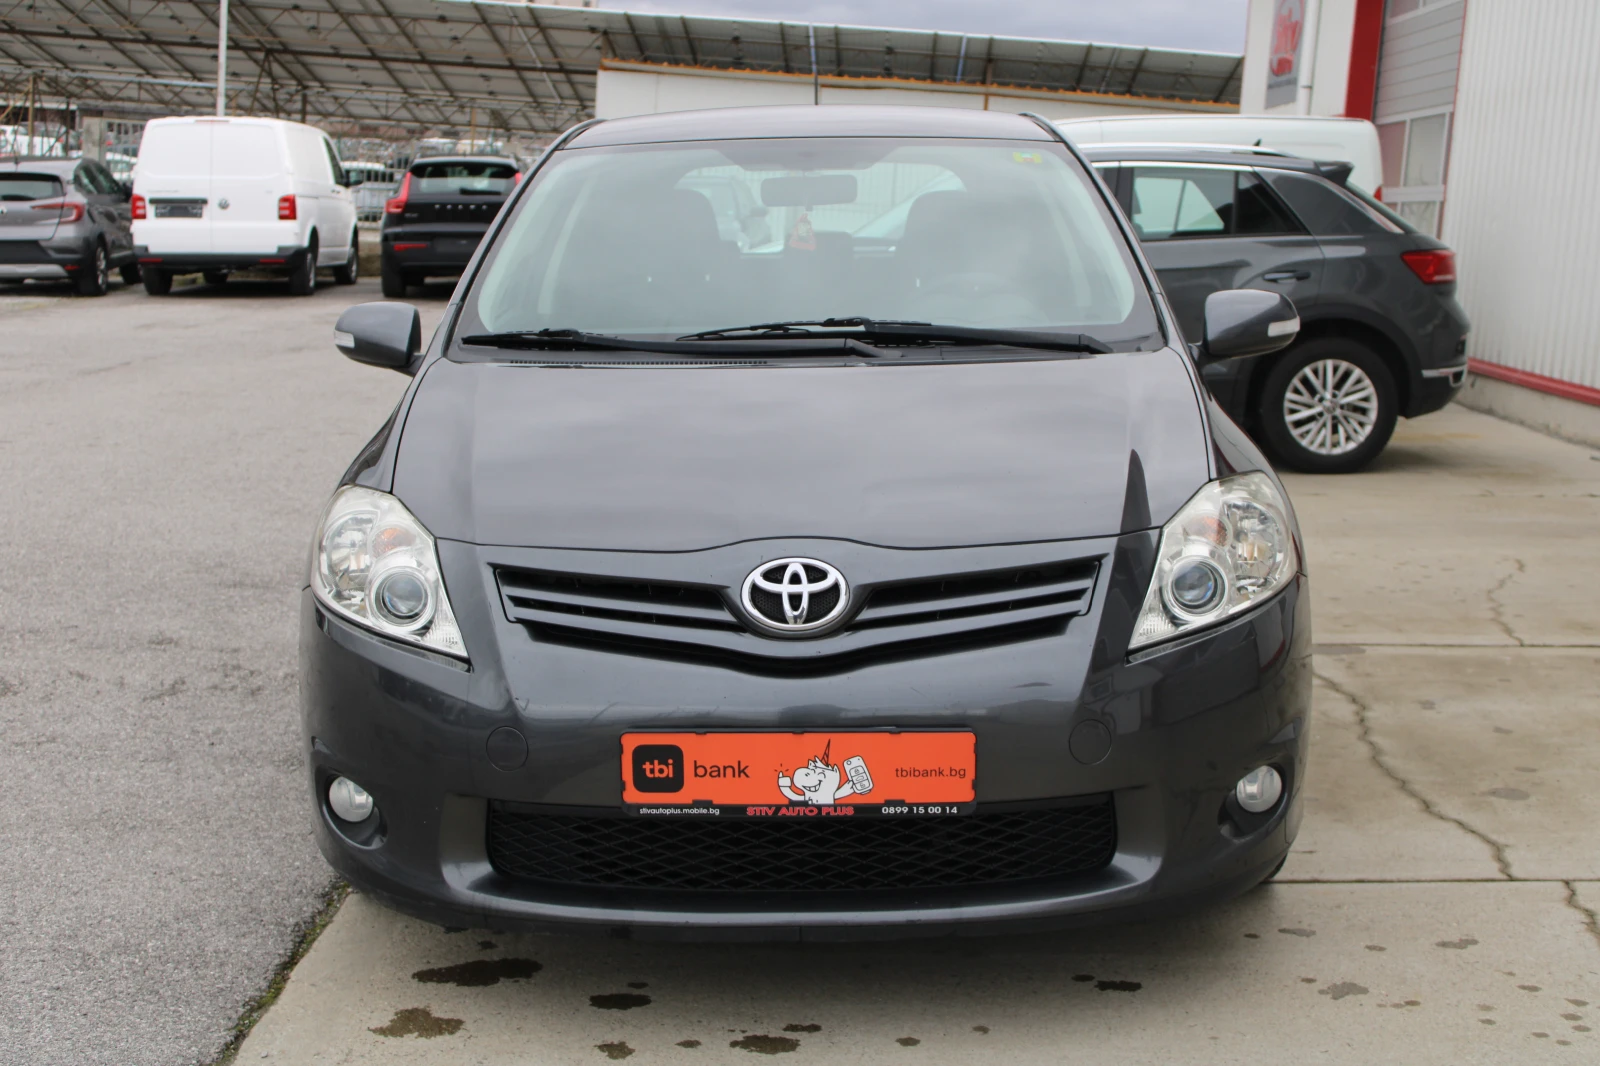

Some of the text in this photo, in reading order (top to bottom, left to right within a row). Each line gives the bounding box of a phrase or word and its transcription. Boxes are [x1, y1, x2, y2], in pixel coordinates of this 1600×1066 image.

[642, 758, 750, 779] tbi bank
[895, 766, 967, 779] tbibank.bg
[639, 807, 720, 816] stivautoplus.mobile.bg
[746, 806, 855, 816] STIV AUTO PLUS
[881, 806, 958, 814] 0899 15 00 14
